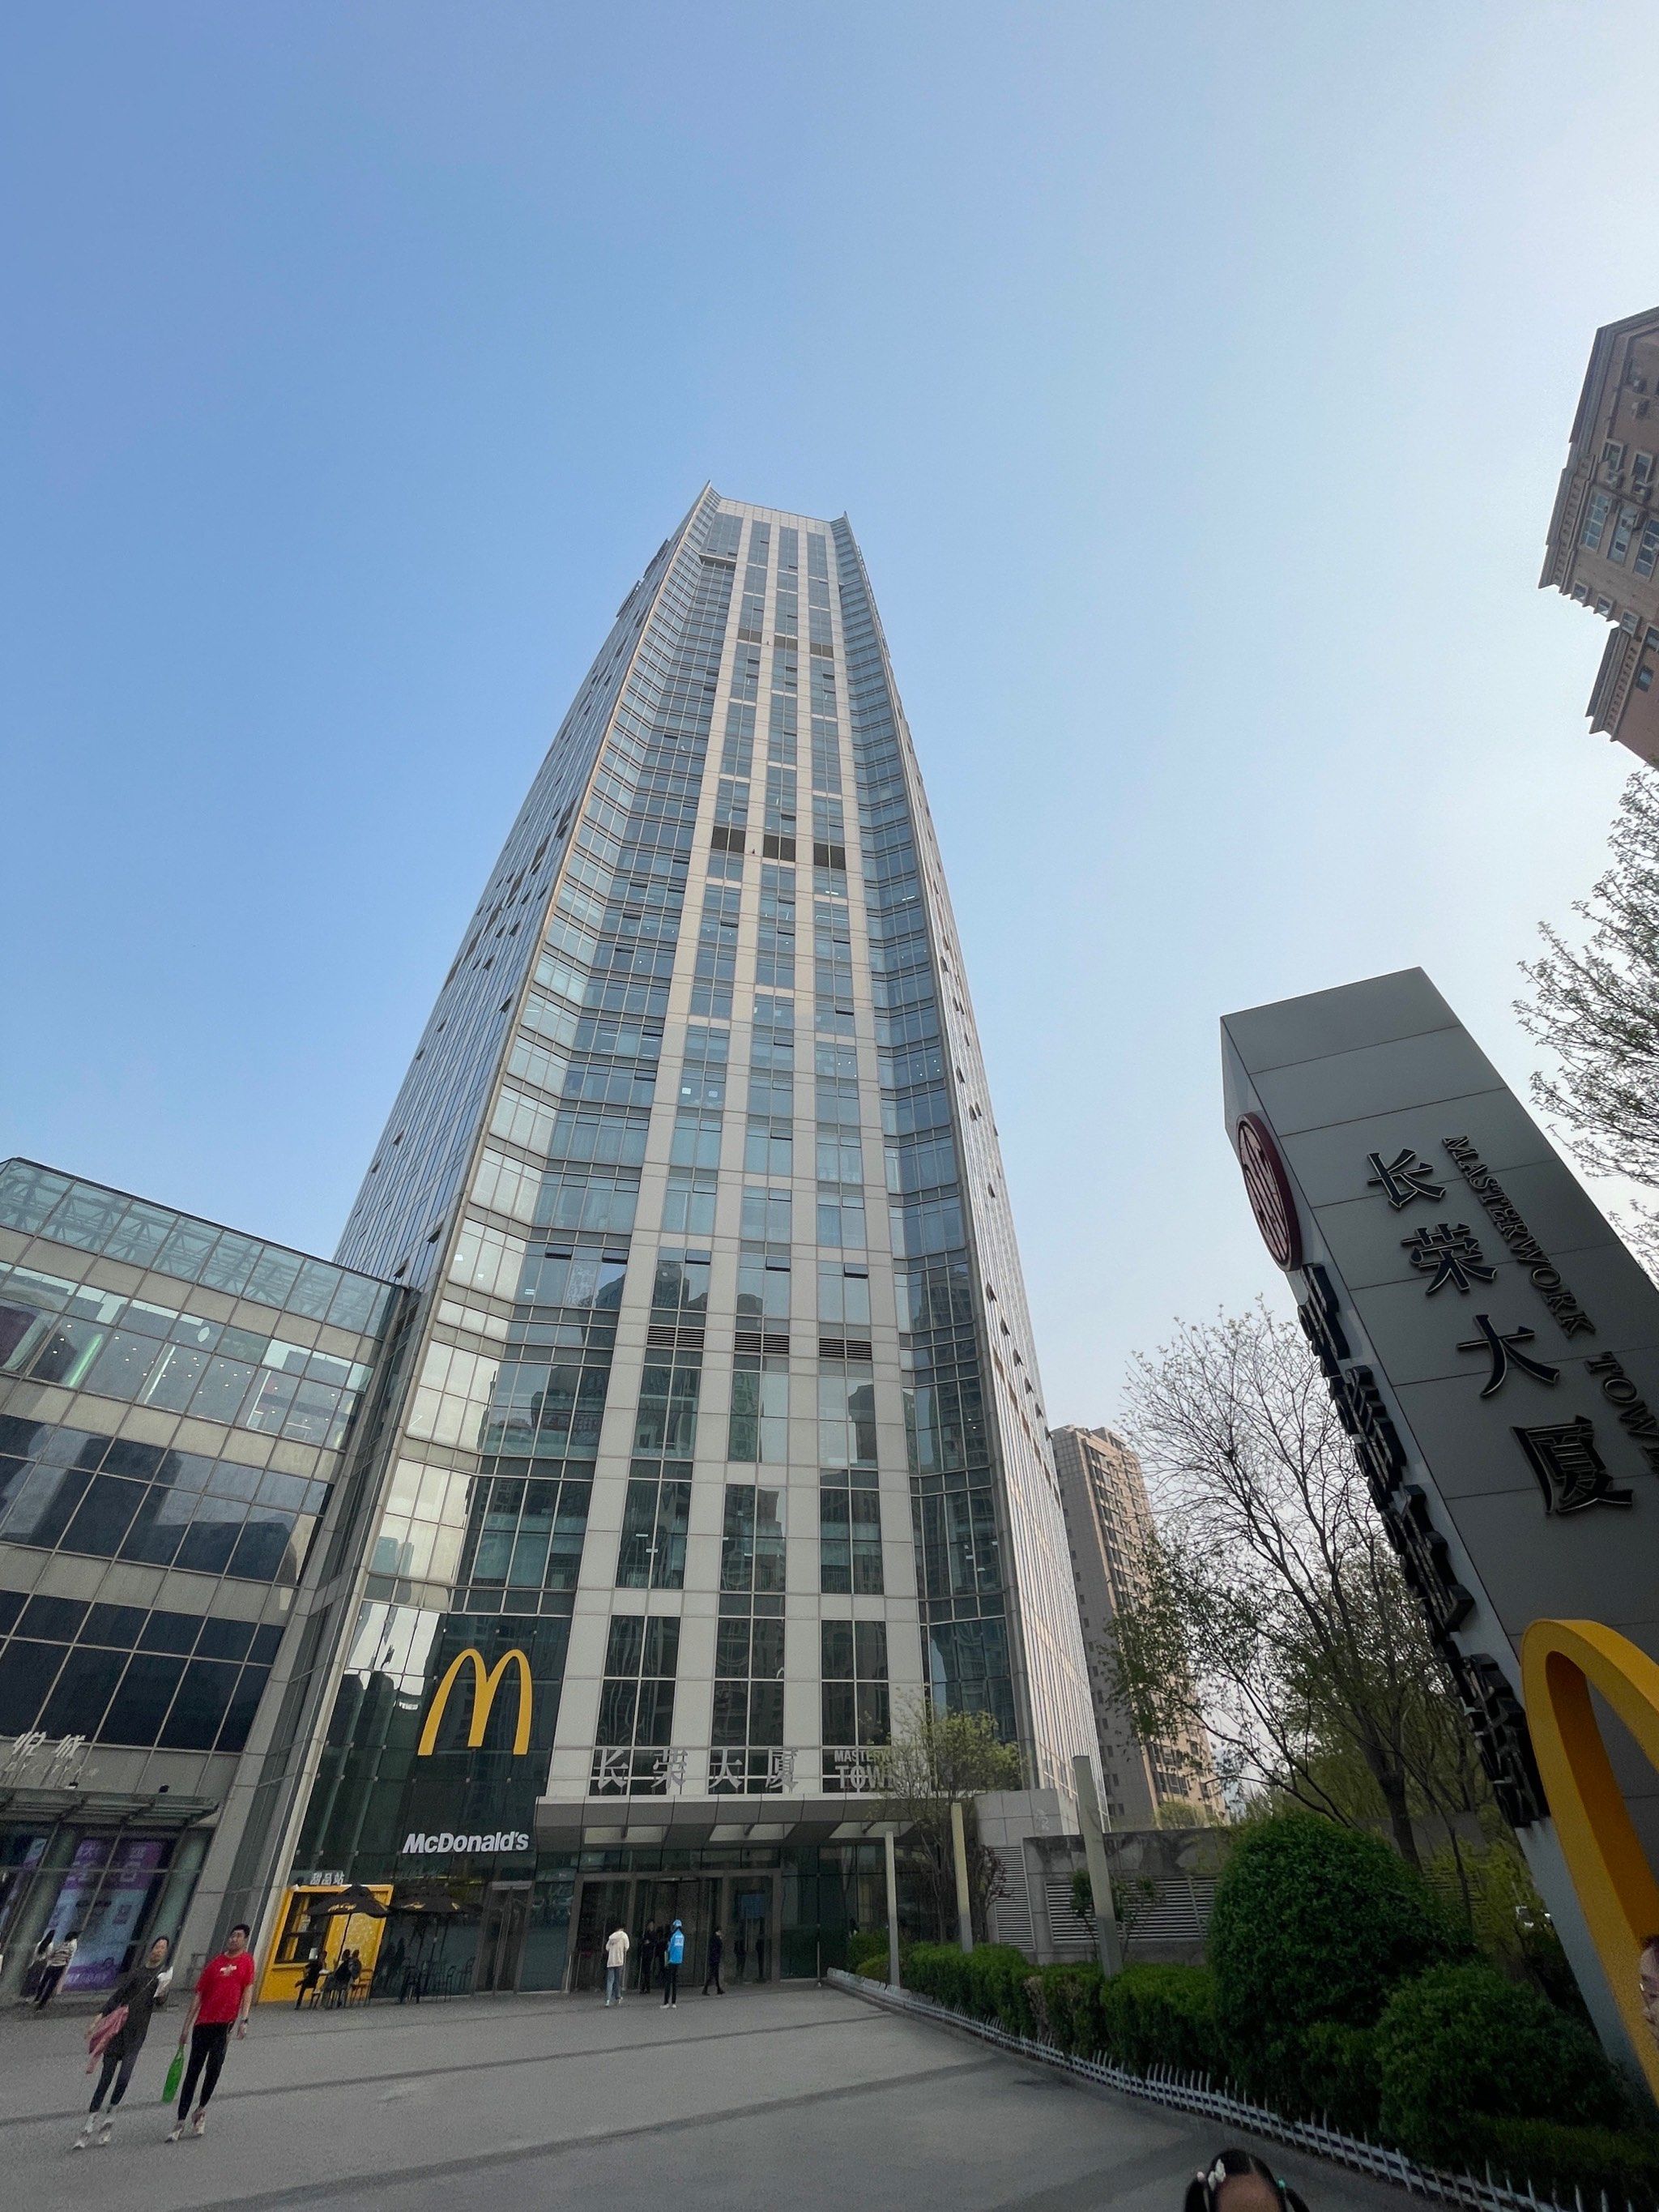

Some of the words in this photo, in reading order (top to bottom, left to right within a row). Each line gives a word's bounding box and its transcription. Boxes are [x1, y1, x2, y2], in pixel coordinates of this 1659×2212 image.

[1442, 1136, 1597, 1339] MASTERWORK
[1367, 1147, 1634, 1515] 长荣大厦
[593, 1748, 799, 1790] 长荣大厦
[402, 1831, 529, 1854] McDonald's
